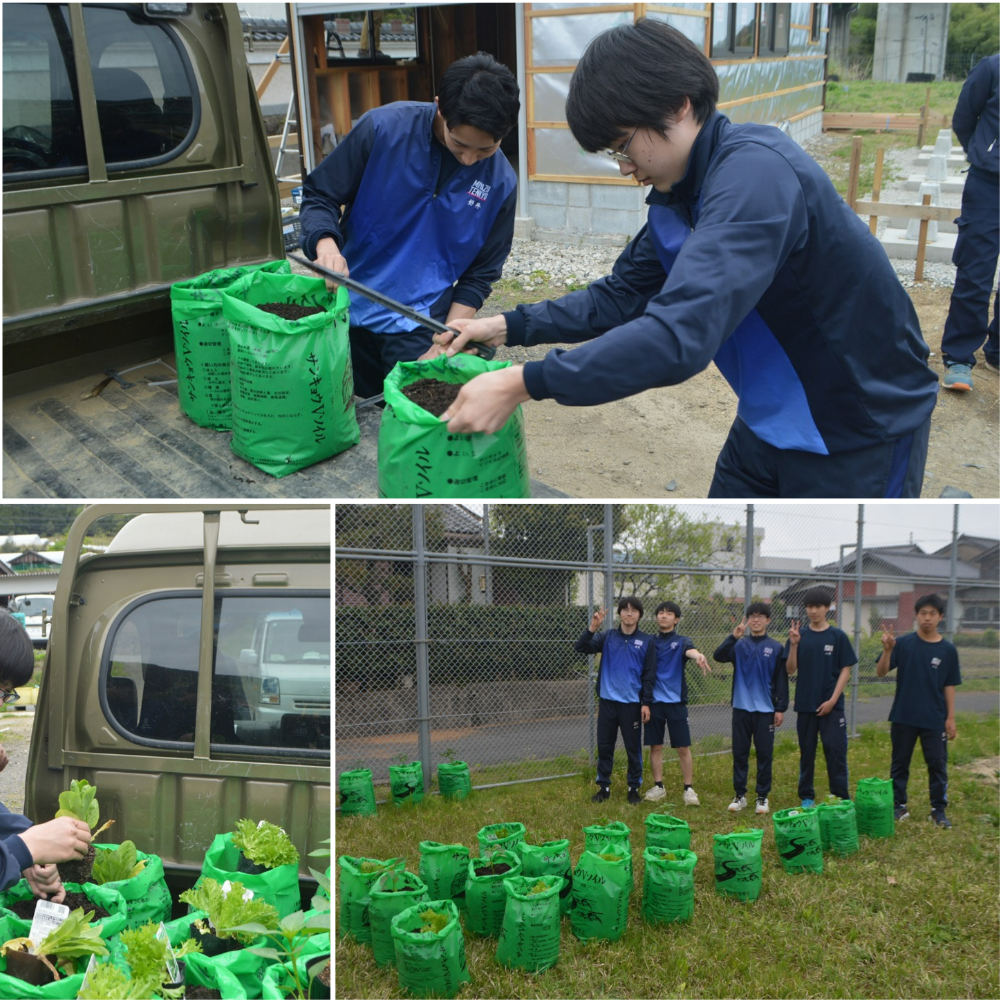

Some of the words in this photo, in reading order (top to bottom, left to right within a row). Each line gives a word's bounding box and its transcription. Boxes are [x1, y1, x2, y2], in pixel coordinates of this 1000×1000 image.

[306, 352, 326, 443] サンキョウVソイル
